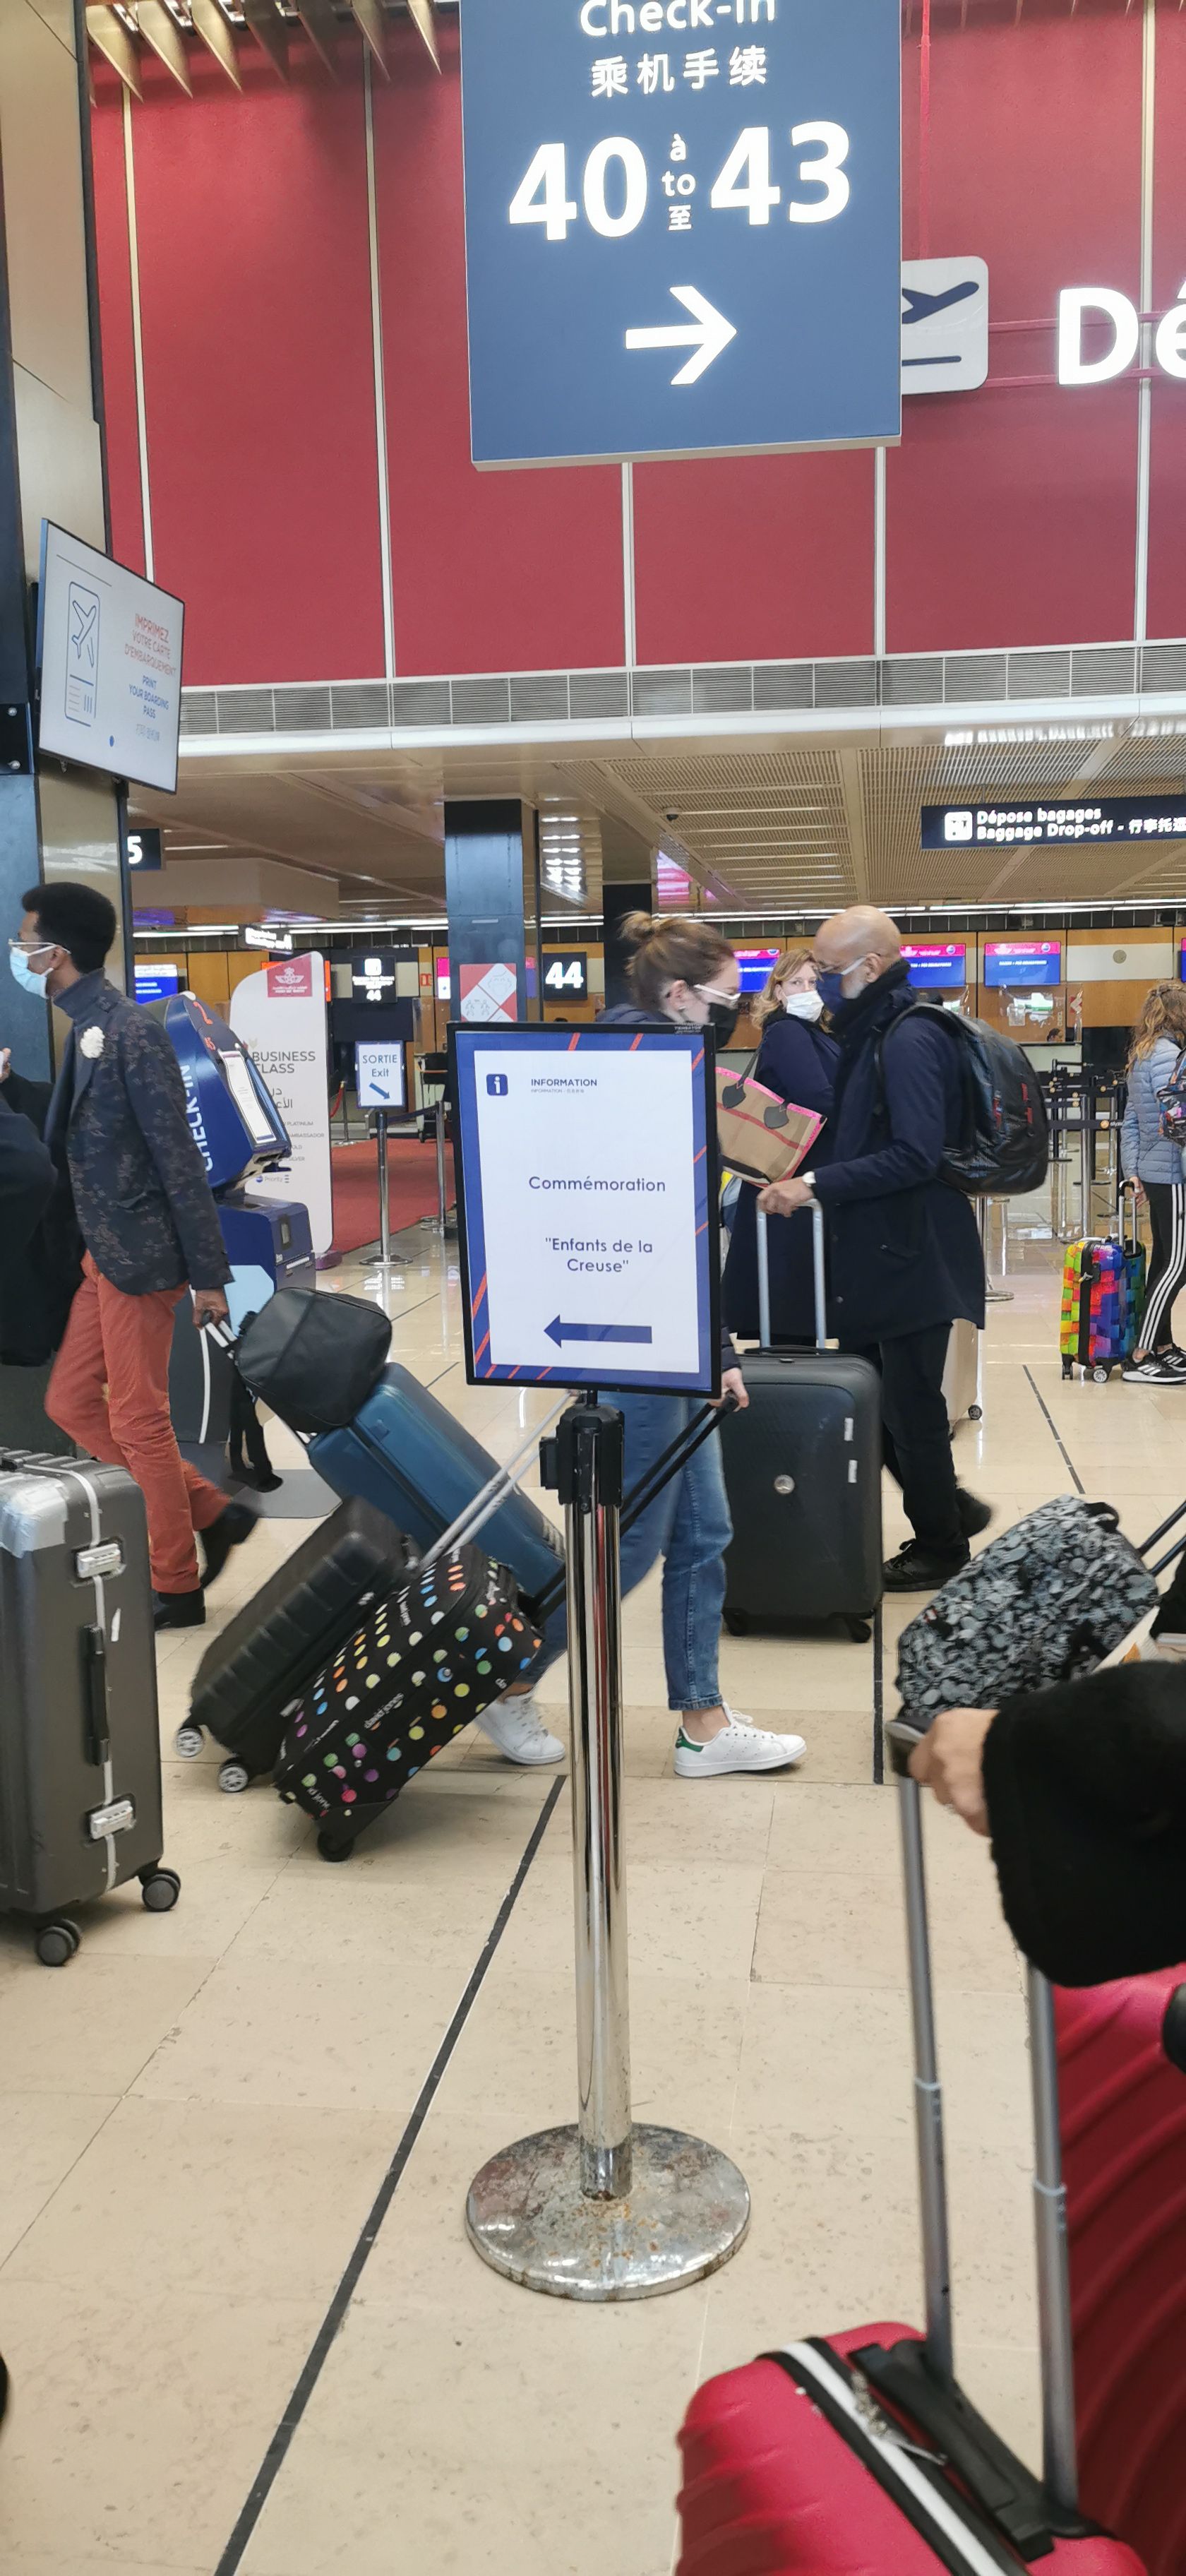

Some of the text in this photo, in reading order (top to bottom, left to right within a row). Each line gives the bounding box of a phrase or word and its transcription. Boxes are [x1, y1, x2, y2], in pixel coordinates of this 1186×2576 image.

[590, 45, 767, 97] 乘机手续
[669, 134, 686, 162] à
[710, 121, 851, 225] 43
[508, 136, 648, 241] 40
[661, 172, 696, 197] to
[669, 205, 692, 231] 至
[977, 808, 1101, 826] Dépose bagages
[977, 825, 1043, 842] Baggage
[1048, 820, 1113, 838] Drop-off
[545, 962, 584, 989] 44
[252, 1051, 316, 1061] BUSINESS
[362, 1054, 398, 1064] SORTIE
[371, 1068, 389, 1078] Exit
[531, 1078, 598, 1087] INFORMATION
[529, 1176, 666, 1192] Commémoration
[545, 1238, 653, 1253] "Enfants de la
[567, 1258, 629, 1272] Creuse"
